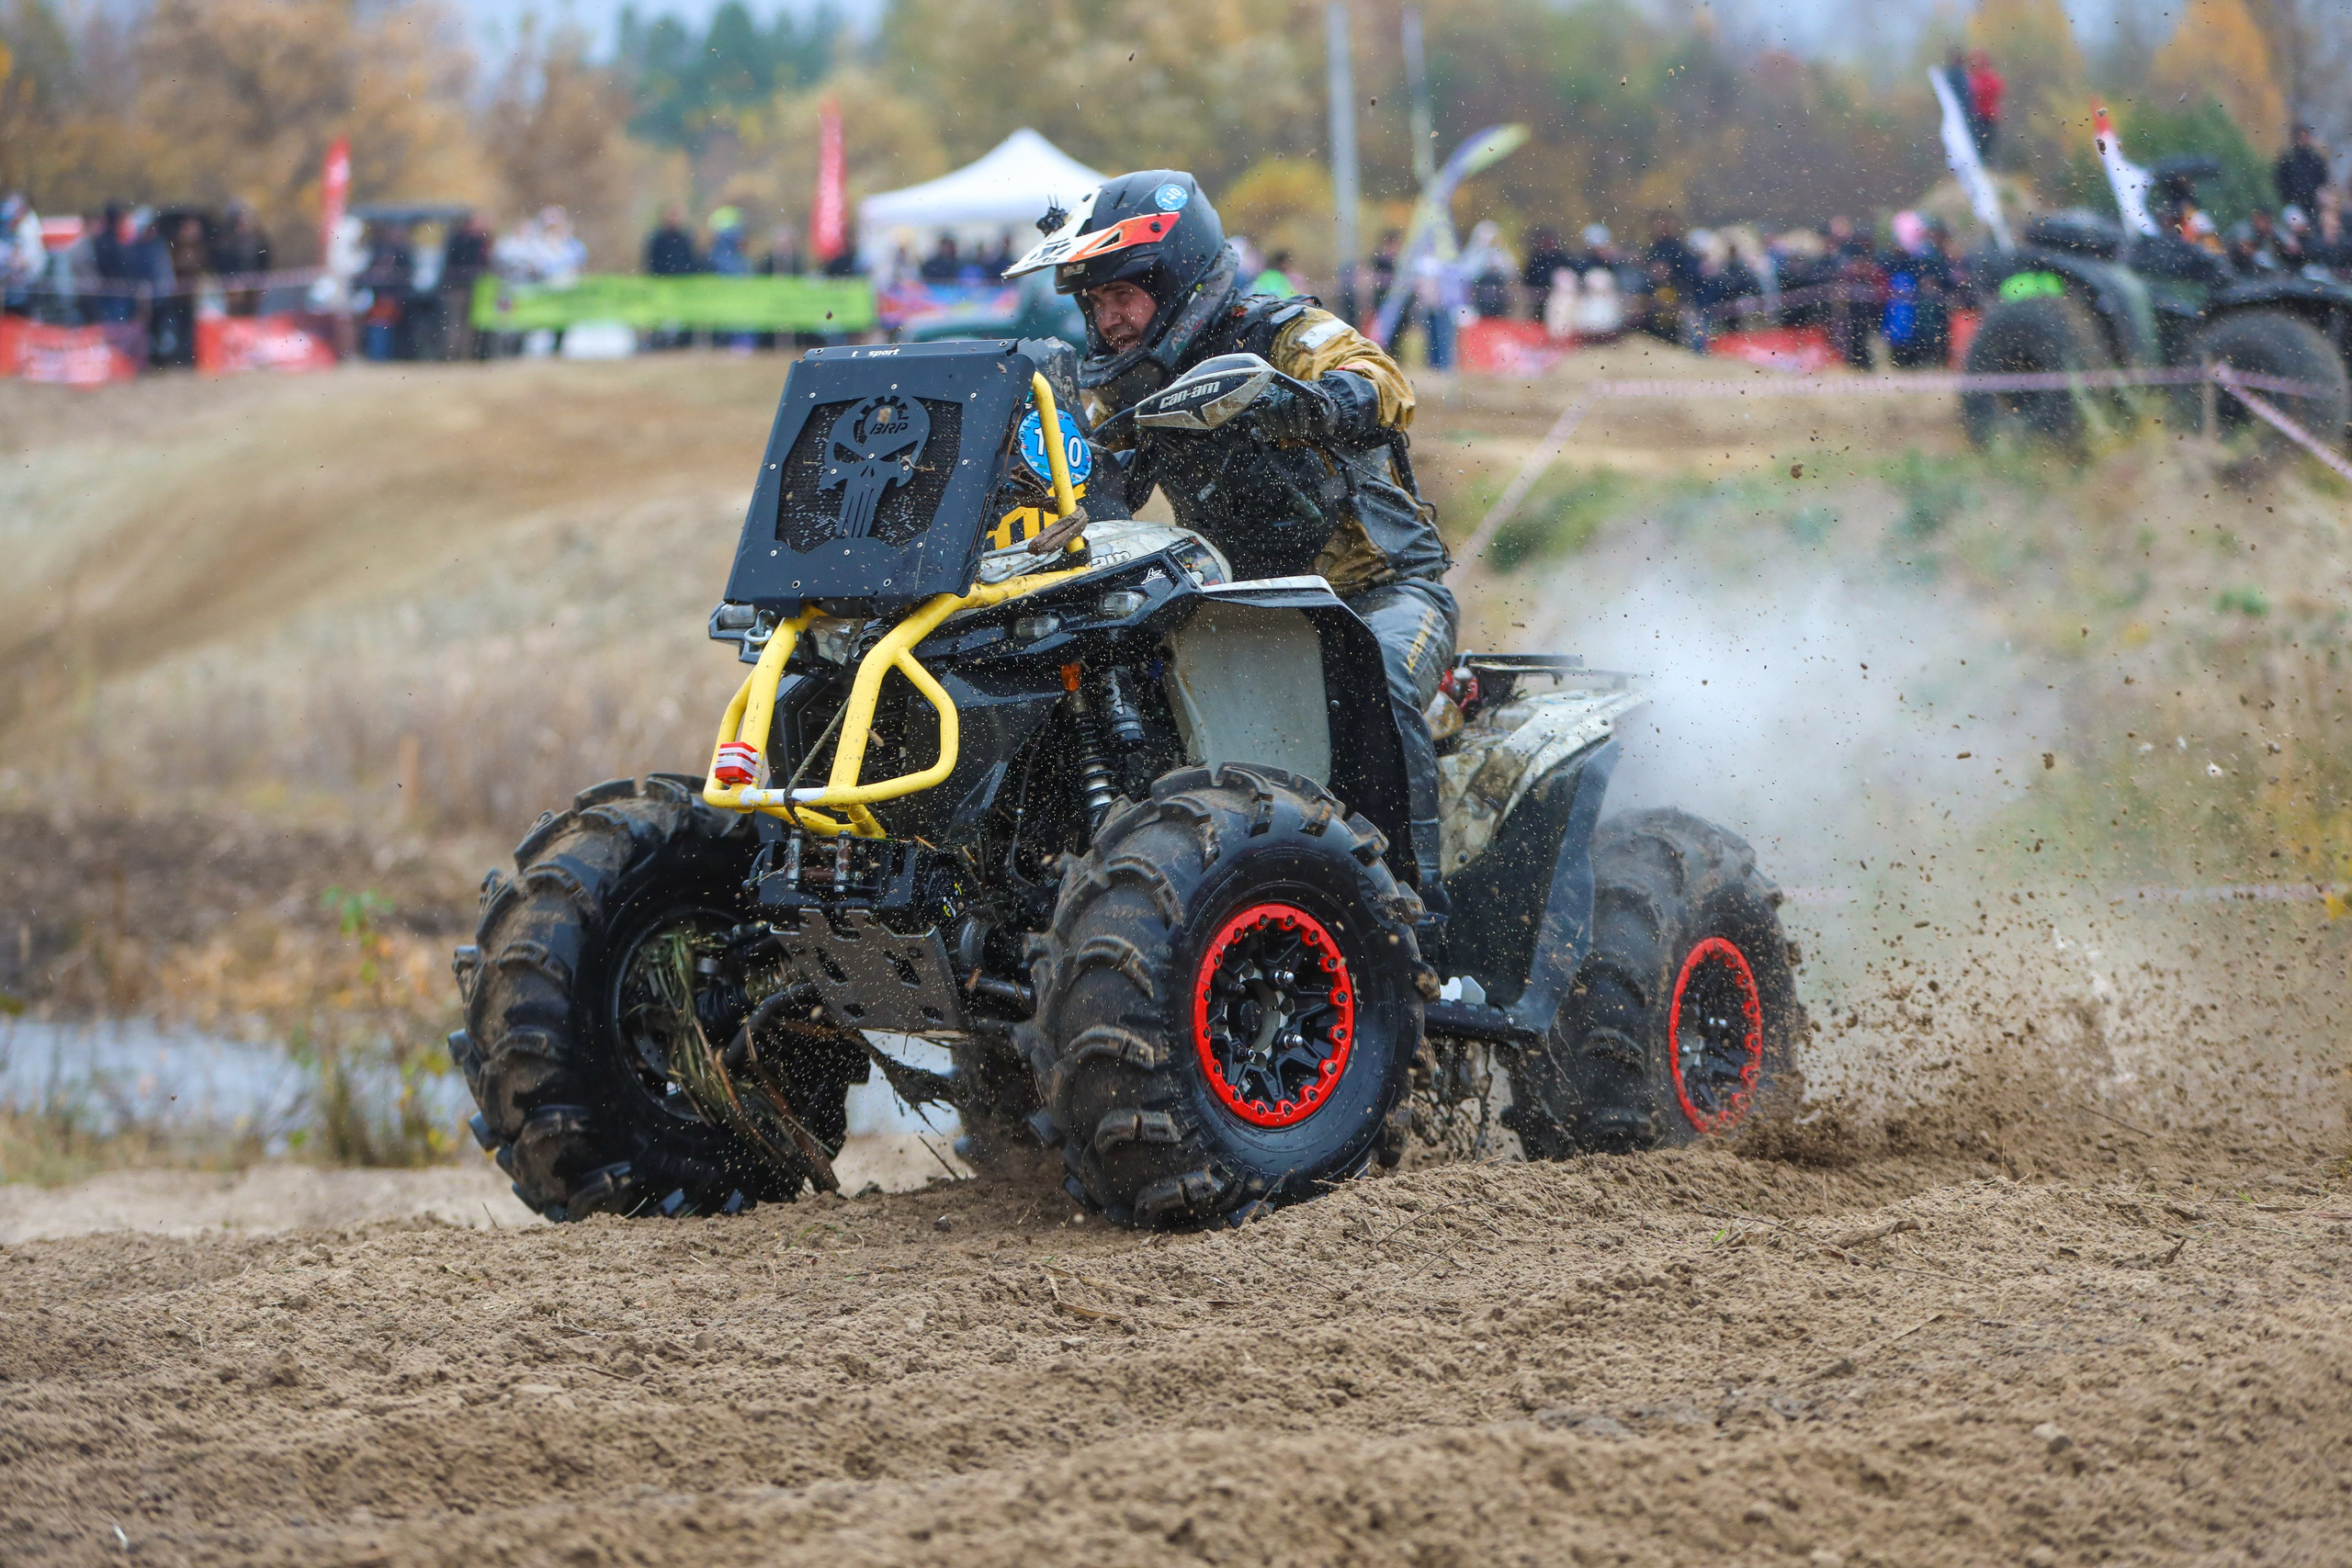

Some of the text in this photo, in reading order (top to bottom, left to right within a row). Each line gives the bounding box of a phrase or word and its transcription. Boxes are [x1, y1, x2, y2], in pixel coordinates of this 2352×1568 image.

[868, 348, 900, 358] sport
[1159, 381, 1221, 410] can-am
[869, 423, 909, 434] BRP
[1034, 427, 1082, 468] 10
